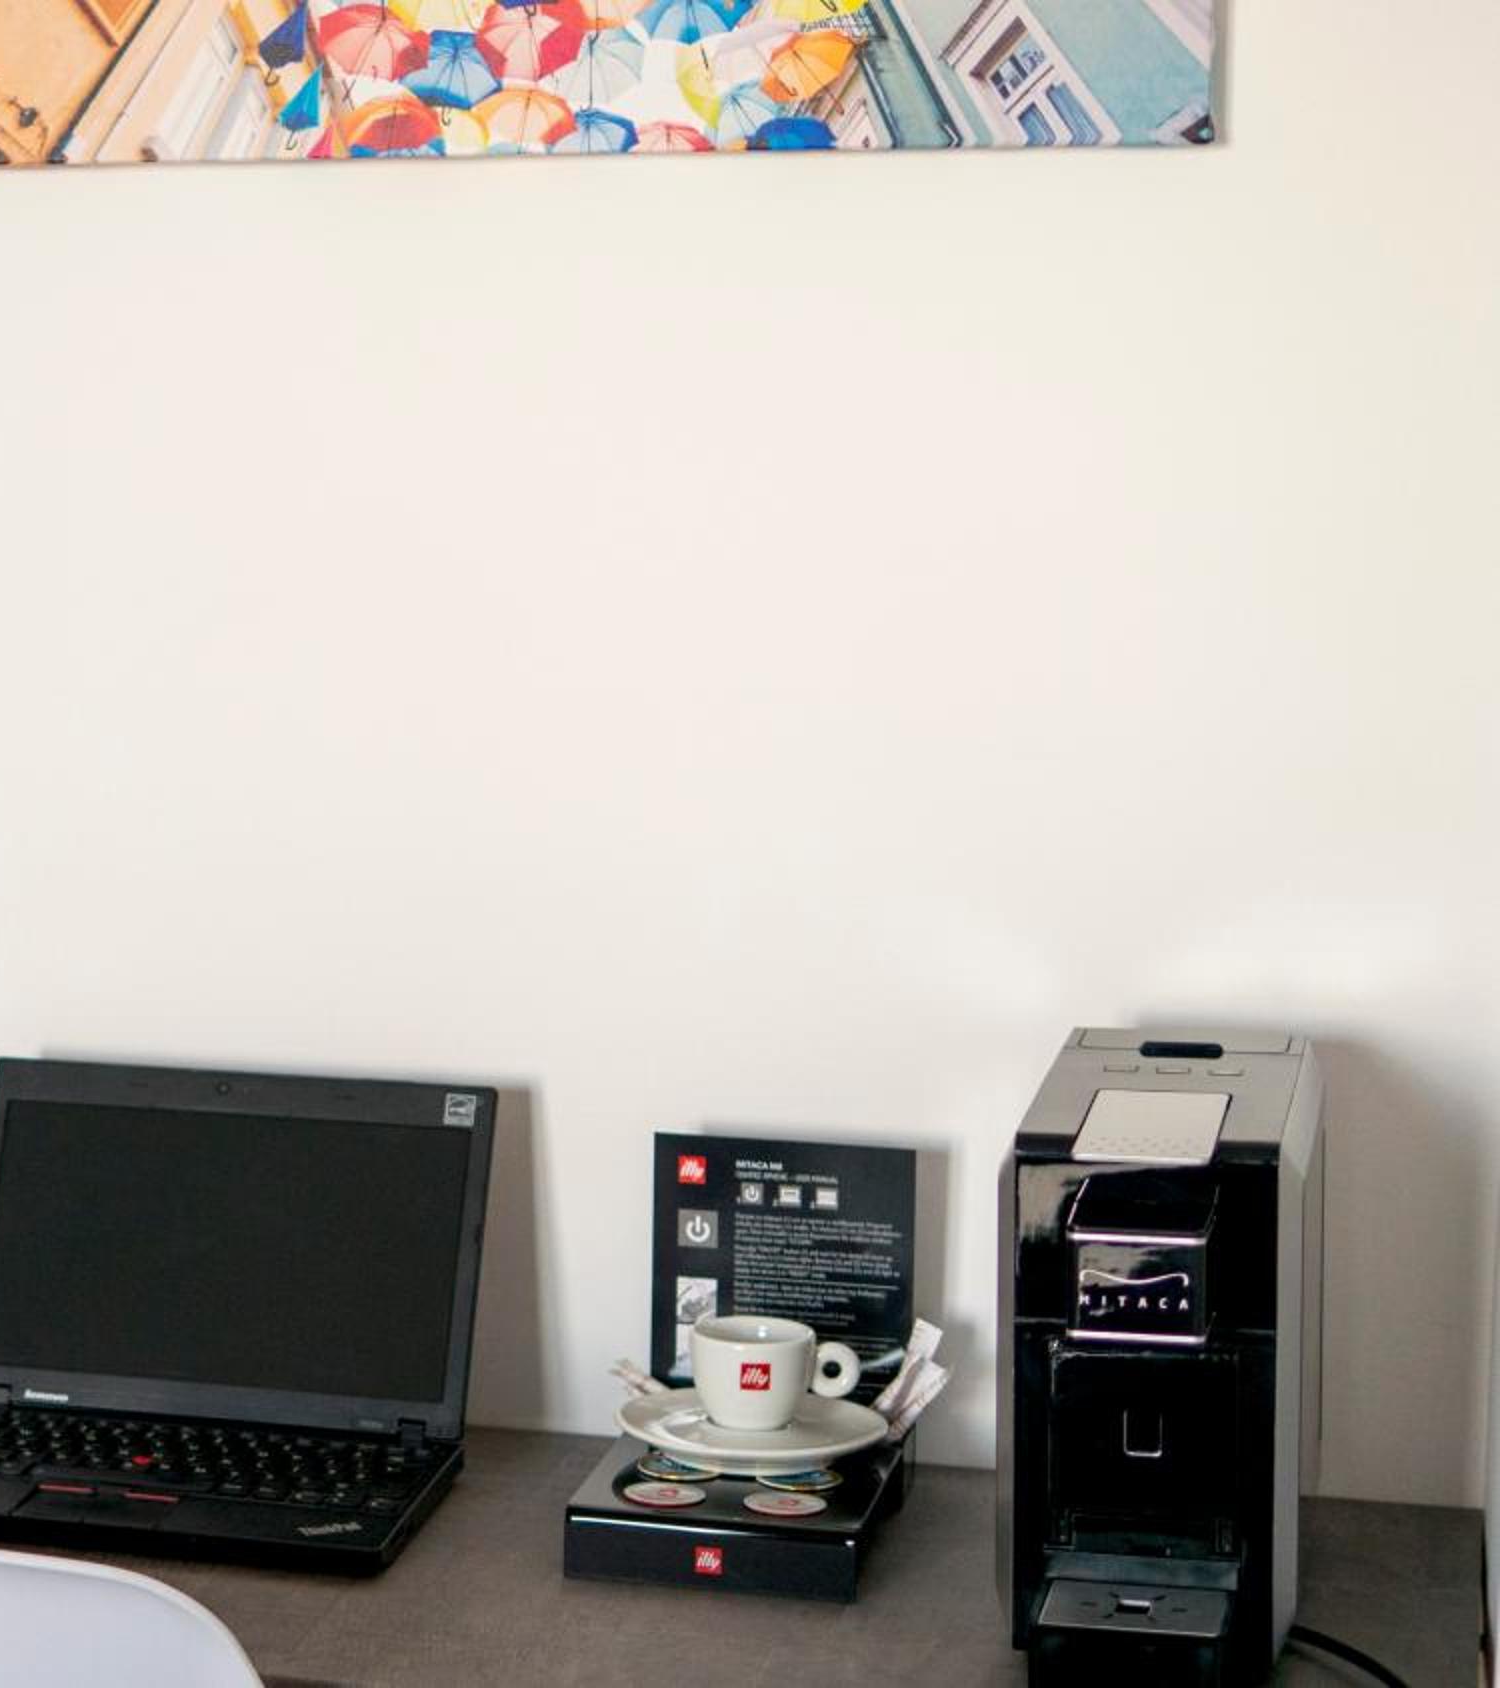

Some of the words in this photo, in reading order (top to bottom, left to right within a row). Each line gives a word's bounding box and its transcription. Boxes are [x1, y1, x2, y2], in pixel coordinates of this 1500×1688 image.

[678, 1159, 706, 1182] illy
[1078, 1294, 1190, 1309] MITACA
[742, 1368, 769, 1388] illy
[297, 1521, 363, 1537] ThinkPad
[696, 1551, 721, 1570] illy
